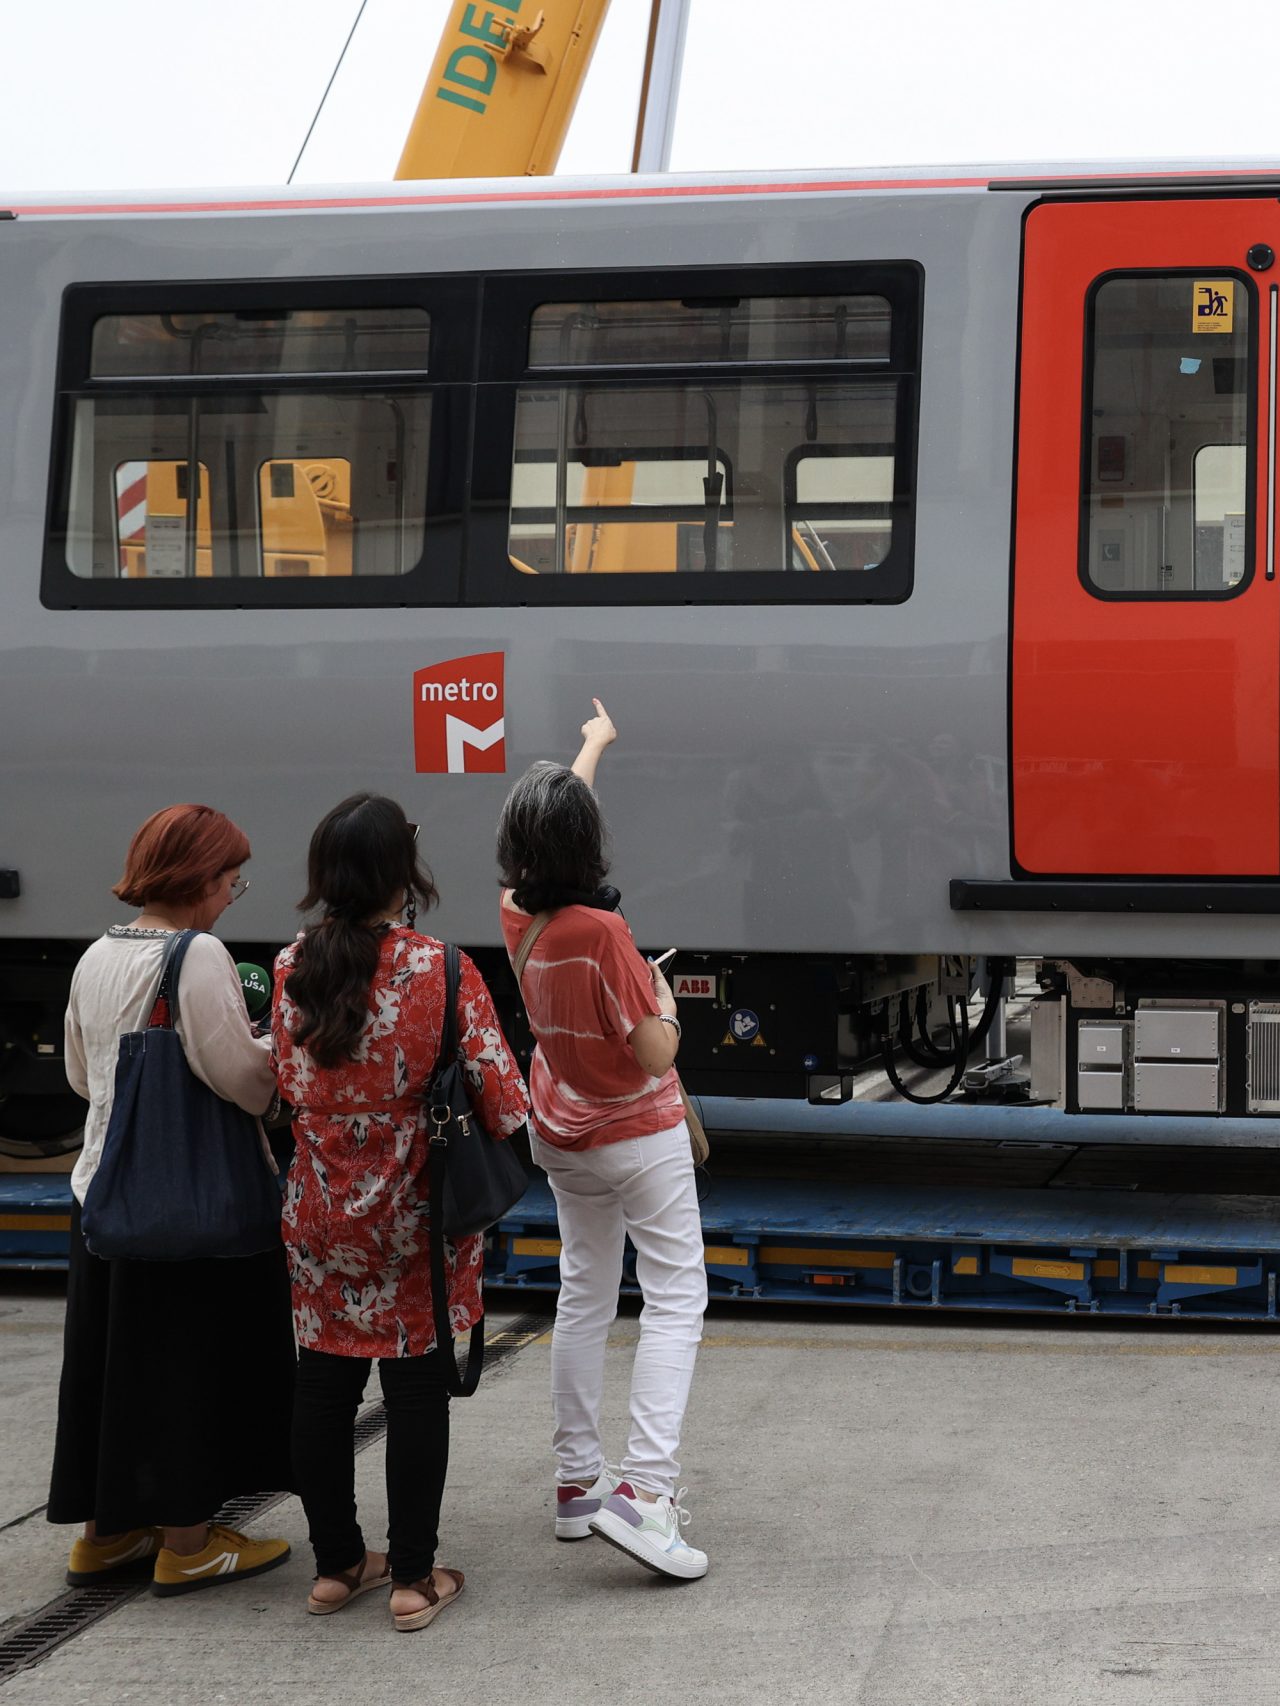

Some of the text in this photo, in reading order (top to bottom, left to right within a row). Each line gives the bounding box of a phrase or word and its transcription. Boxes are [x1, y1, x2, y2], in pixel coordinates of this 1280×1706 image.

[436, 0, 524, 115] IDE
[421, 677, 498, 702] metro
[240, 979, 266, 994] USA
[678, 979, 711, 994] ABB
